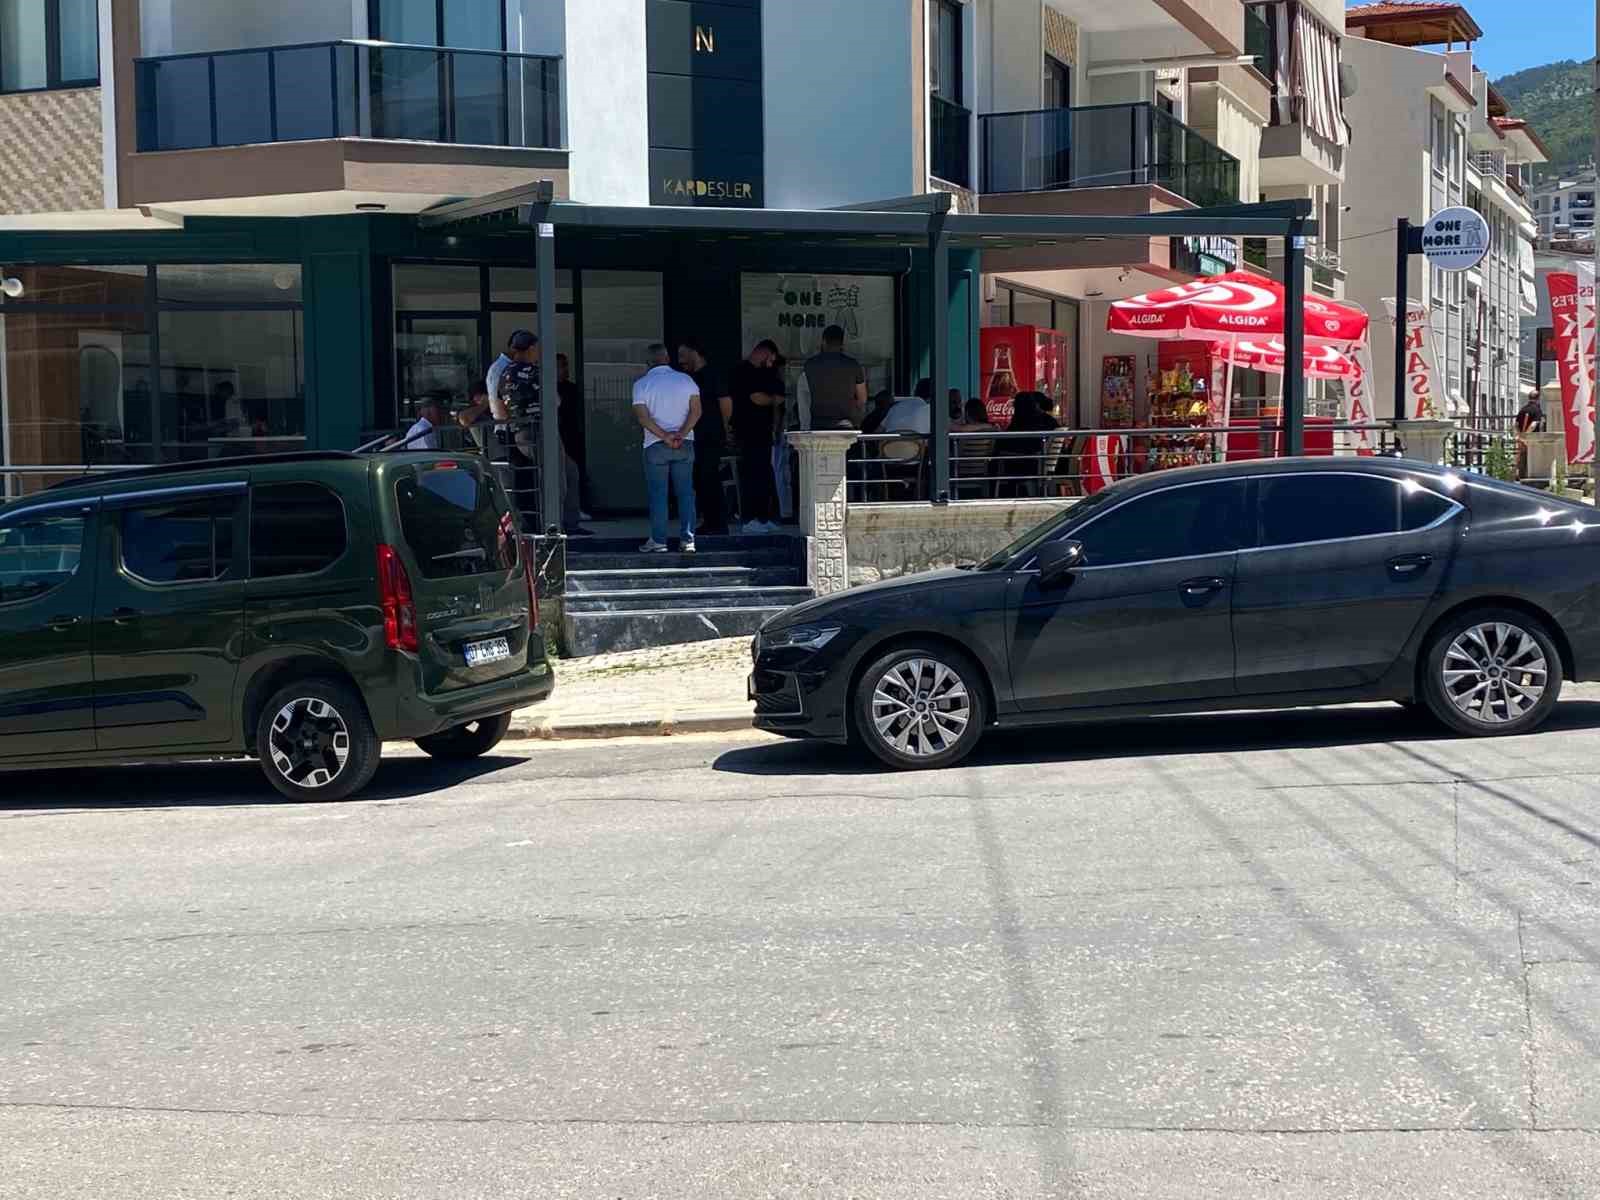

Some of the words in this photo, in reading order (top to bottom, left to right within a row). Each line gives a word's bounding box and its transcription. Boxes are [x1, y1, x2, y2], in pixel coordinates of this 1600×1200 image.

[695, 25, 714, 52] N
[1434, 220, 1461, 231] ONE
[1423, 234, 1461, 247] MORE
[783, 290, 822, 306] ONE
[778, 312, 826, 328] MORE
[1129, 313, 1164, 325] ALGIDA
[1218, 313, 1266, 326] ALGIDA
